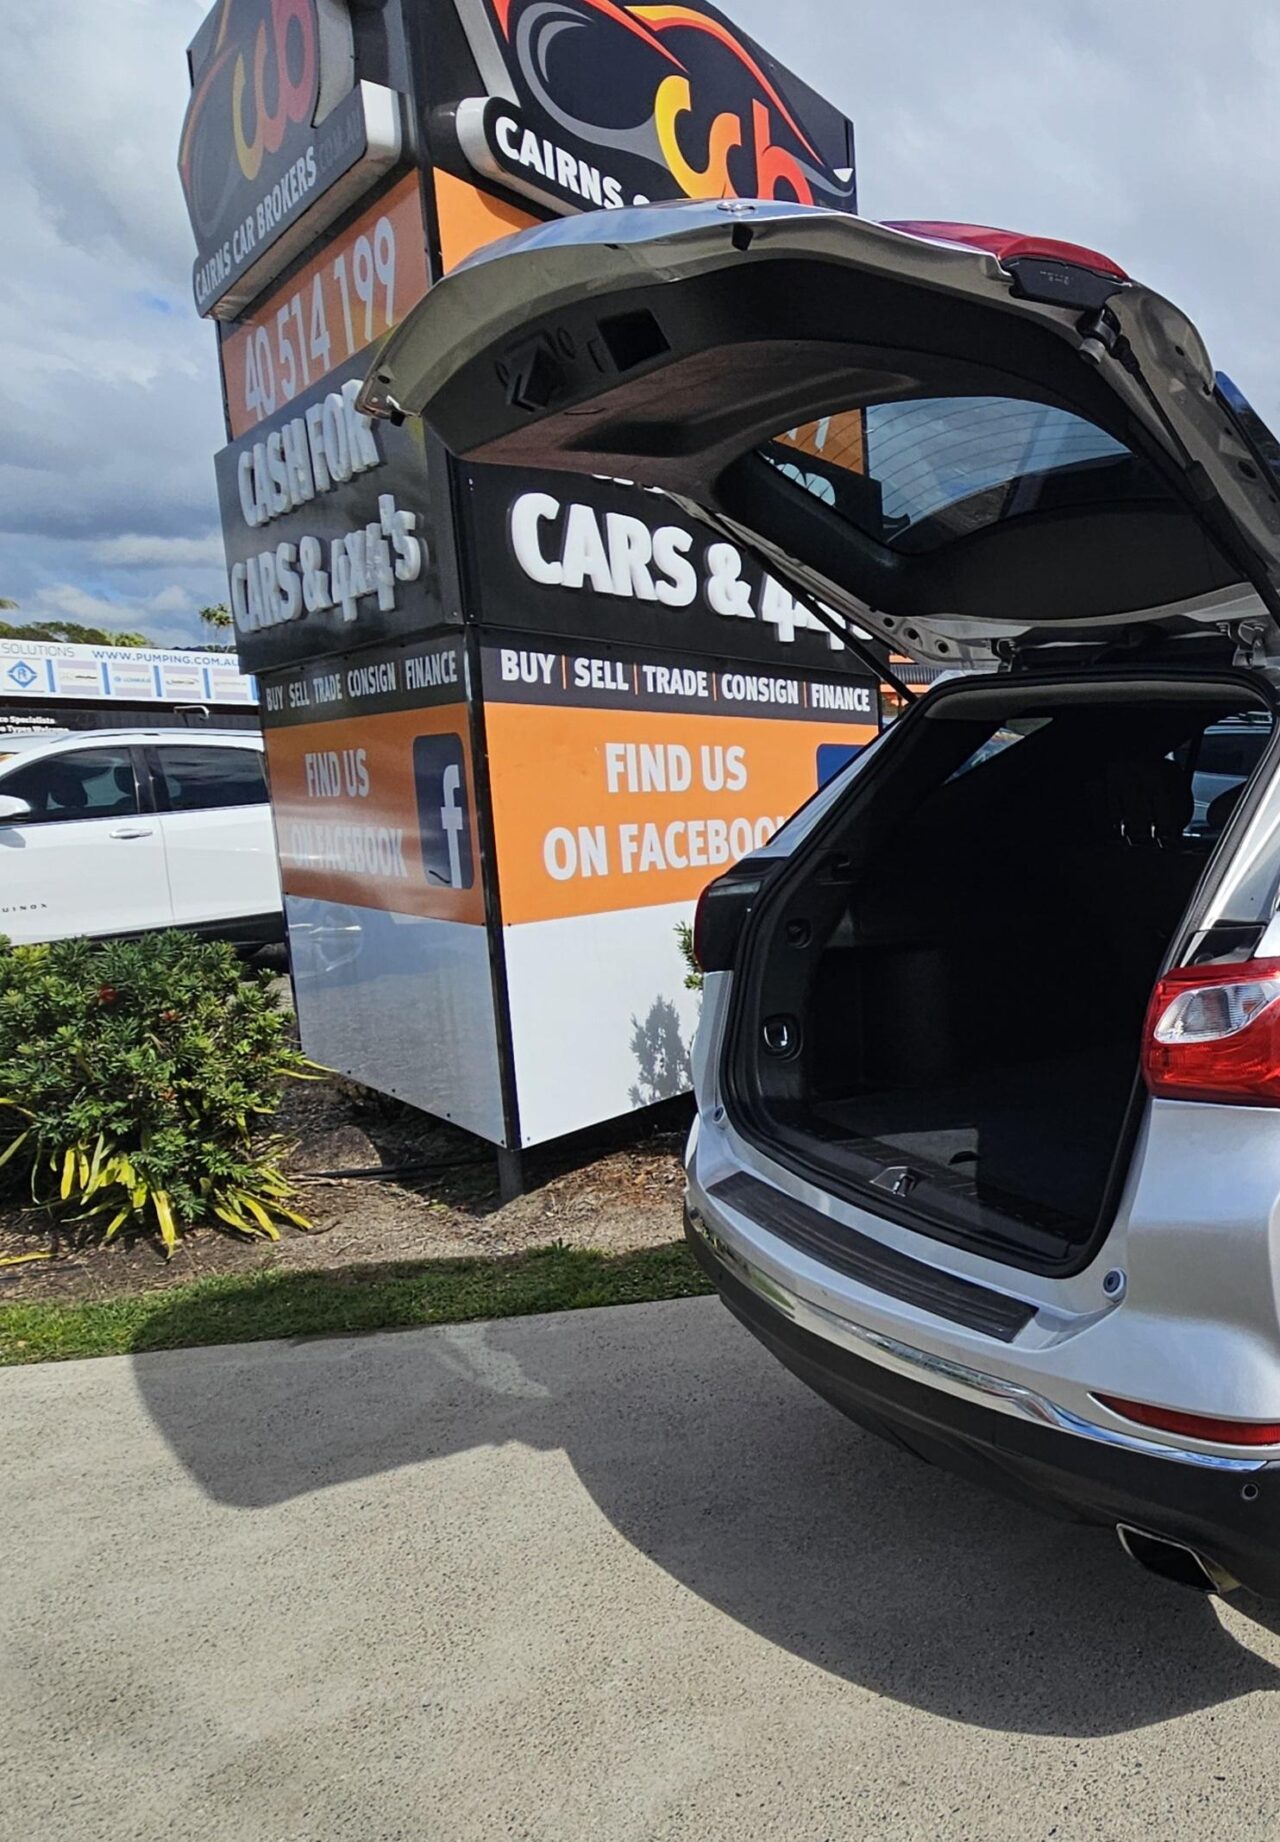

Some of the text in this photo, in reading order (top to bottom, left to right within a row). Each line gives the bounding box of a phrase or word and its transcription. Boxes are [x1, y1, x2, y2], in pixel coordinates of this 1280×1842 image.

[495, 116, 625, 209] CAIRNS
[195, 241, 231, 304] CAIRNS
[232, 216, 257, 264] CAR
[245, 216, 396, 419] 40 514 199
[237, 418, 315, 527] CASH
[231, 542, 303, 633] CARS
[299, 536, 333, 613] &
[510, 492, 697, 607] CARS
[707, 543, 755, 618] &
[1, 643, 75, 658] SOLUTIONS
[266, 650, 457, 712] BUY SELL TRADE CONSIGN FINANCE
[500, 649, 870, 713] BUY SELL TRADE CONSIGN FINANCE
[305, 748, 369, 797] FIND US
[605, 743, 748, 793] FIND US
[314, 824, 408, 878] FACEBOOK
[543, 816, 792, 881] ON FACEBOO
